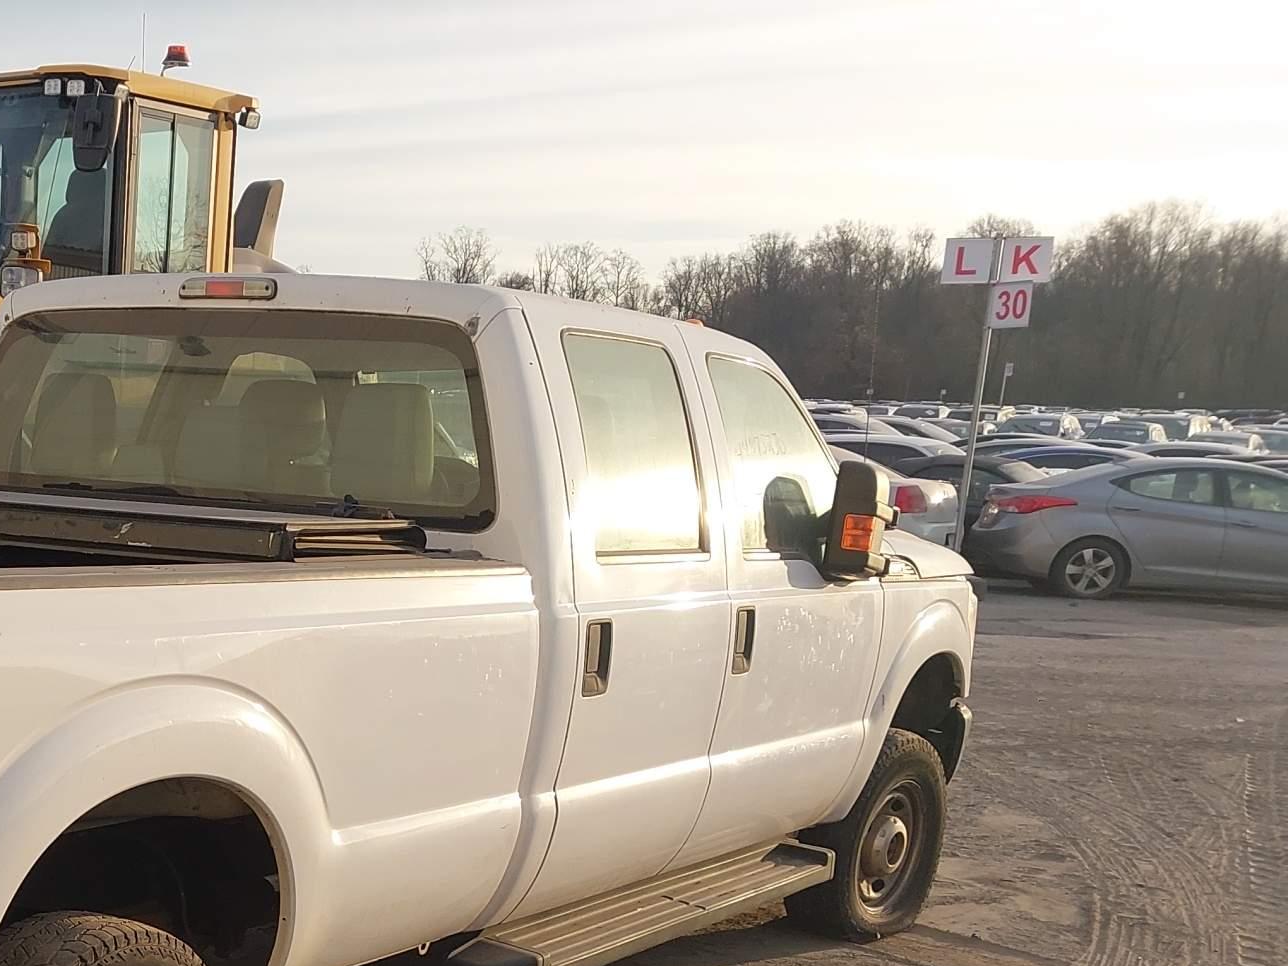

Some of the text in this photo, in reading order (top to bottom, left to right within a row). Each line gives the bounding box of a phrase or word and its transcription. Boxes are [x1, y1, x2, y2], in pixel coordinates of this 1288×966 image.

[955, 246, 977, 275] L
[1011, 244, 1042, 275] K
[995, 289, 1028, 321] 30
